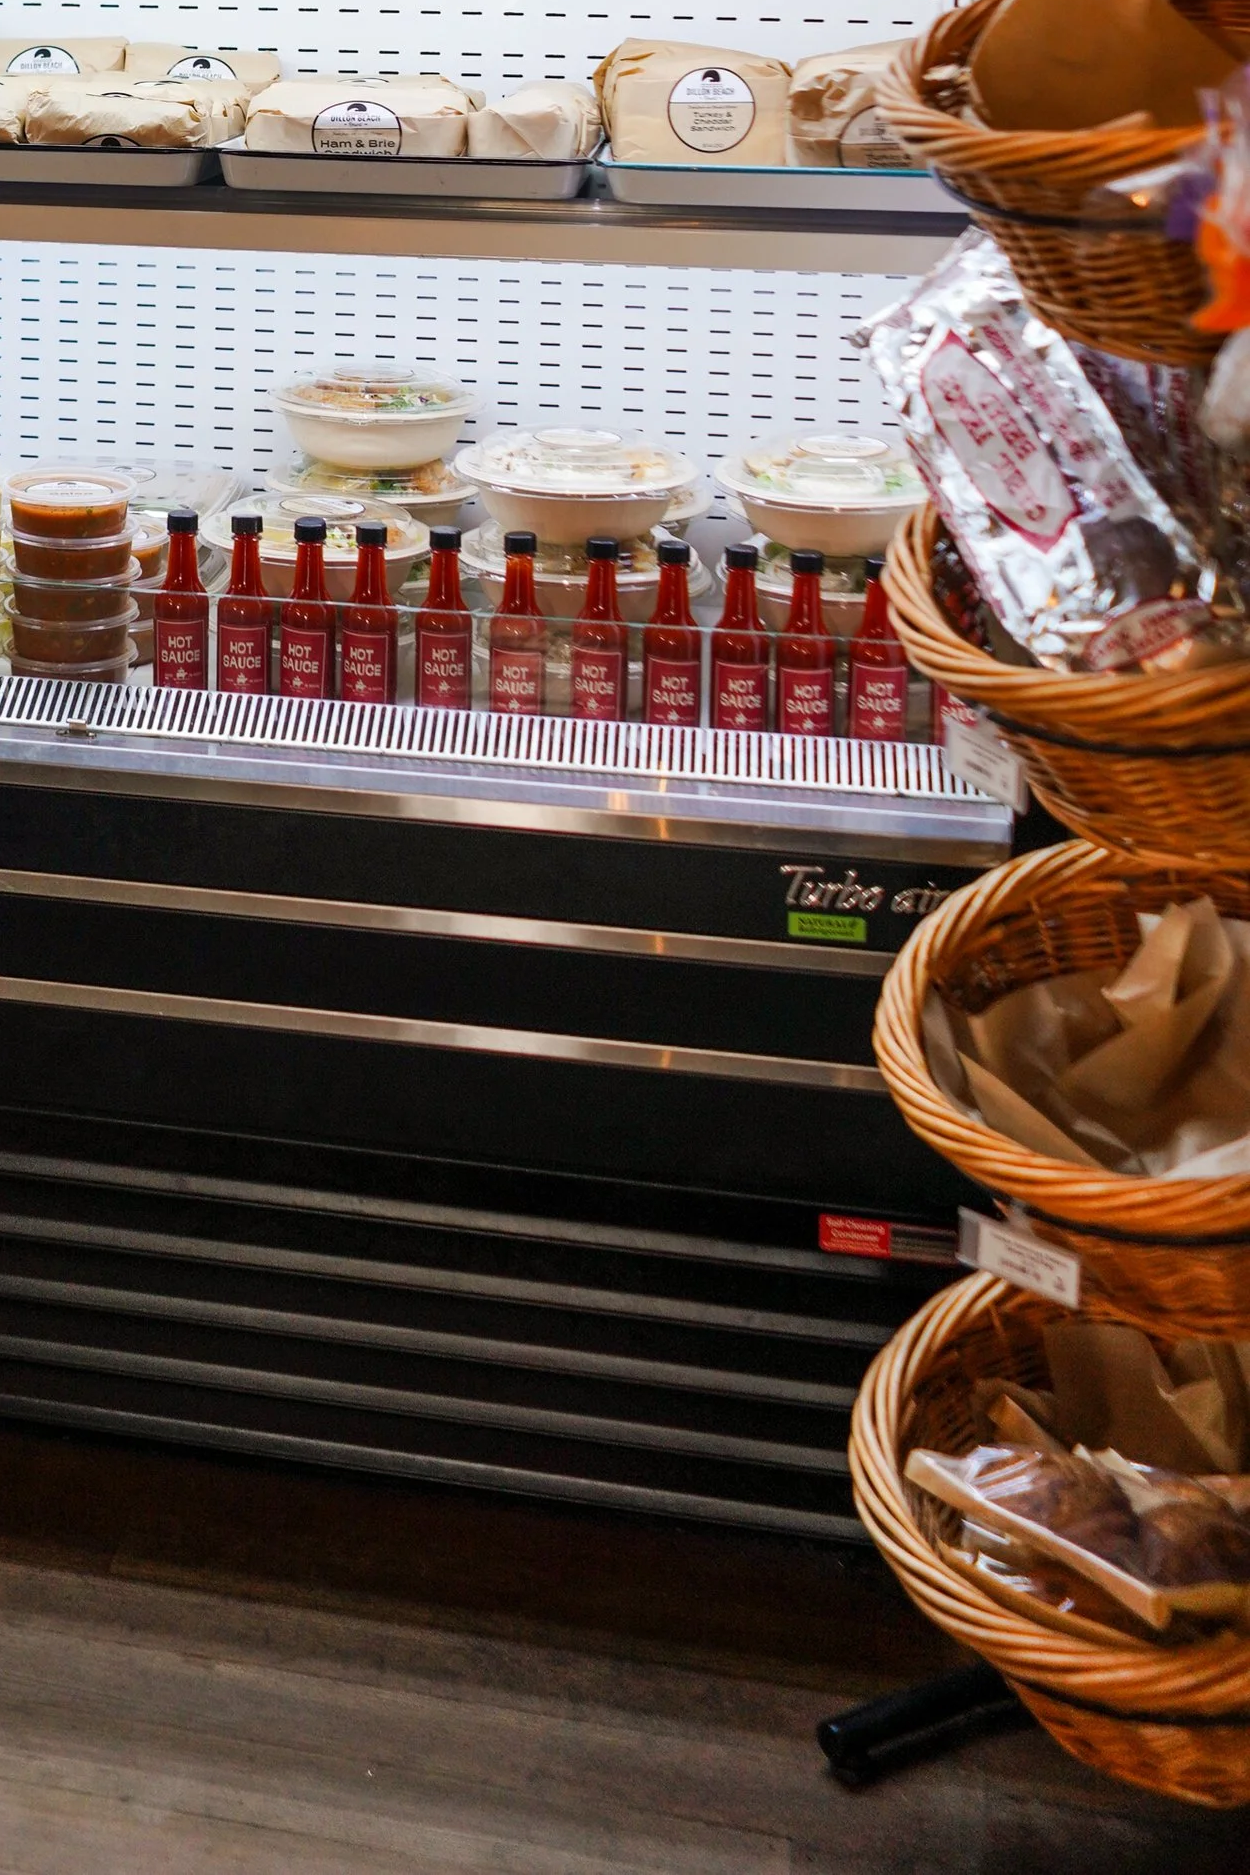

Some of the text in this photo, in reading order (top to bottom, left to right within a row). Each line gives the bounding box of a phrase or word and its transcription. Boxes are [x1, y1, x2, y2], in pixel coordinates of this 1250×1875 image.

[320, 139, 396, 148] Ham & Brie
[168, 636, 193, 648] HOT
[229, 641, 254, 655] HOT
[161, 649, 200, 663] SAUCE
[288, 643, 311, 657] HOT
[349, 646, 374, 661] HOT
[432, 648, 457, 662] HOT
[223, 655, 261, 669] SAUCE
[282, 658, 319, 674] SAUCE
[344, 660, 382, 677] SAUCE
[424, 662, 465, 677] SAUCE
[502, 665, 528, 681] HOT
[580, 663, 606, 679] HOT
[495, 680, 536, 695] SAUCE
[574, 678, 615, 694] SAUCE
[661, 676, 688, 691] HOT
[728, 678, 754, 693] HOT
[865, 682, 895, 697] HOT
[652, 690, 695, 706] SAUCE
[793, 684, 821, 699] HOT
[720, 693, 762, 708] SAUCE
[785, 698, 828, 715] SAUCE
[857, 697, 902, 713] SAUCE
[780, 865, 885, 911] Turbo
